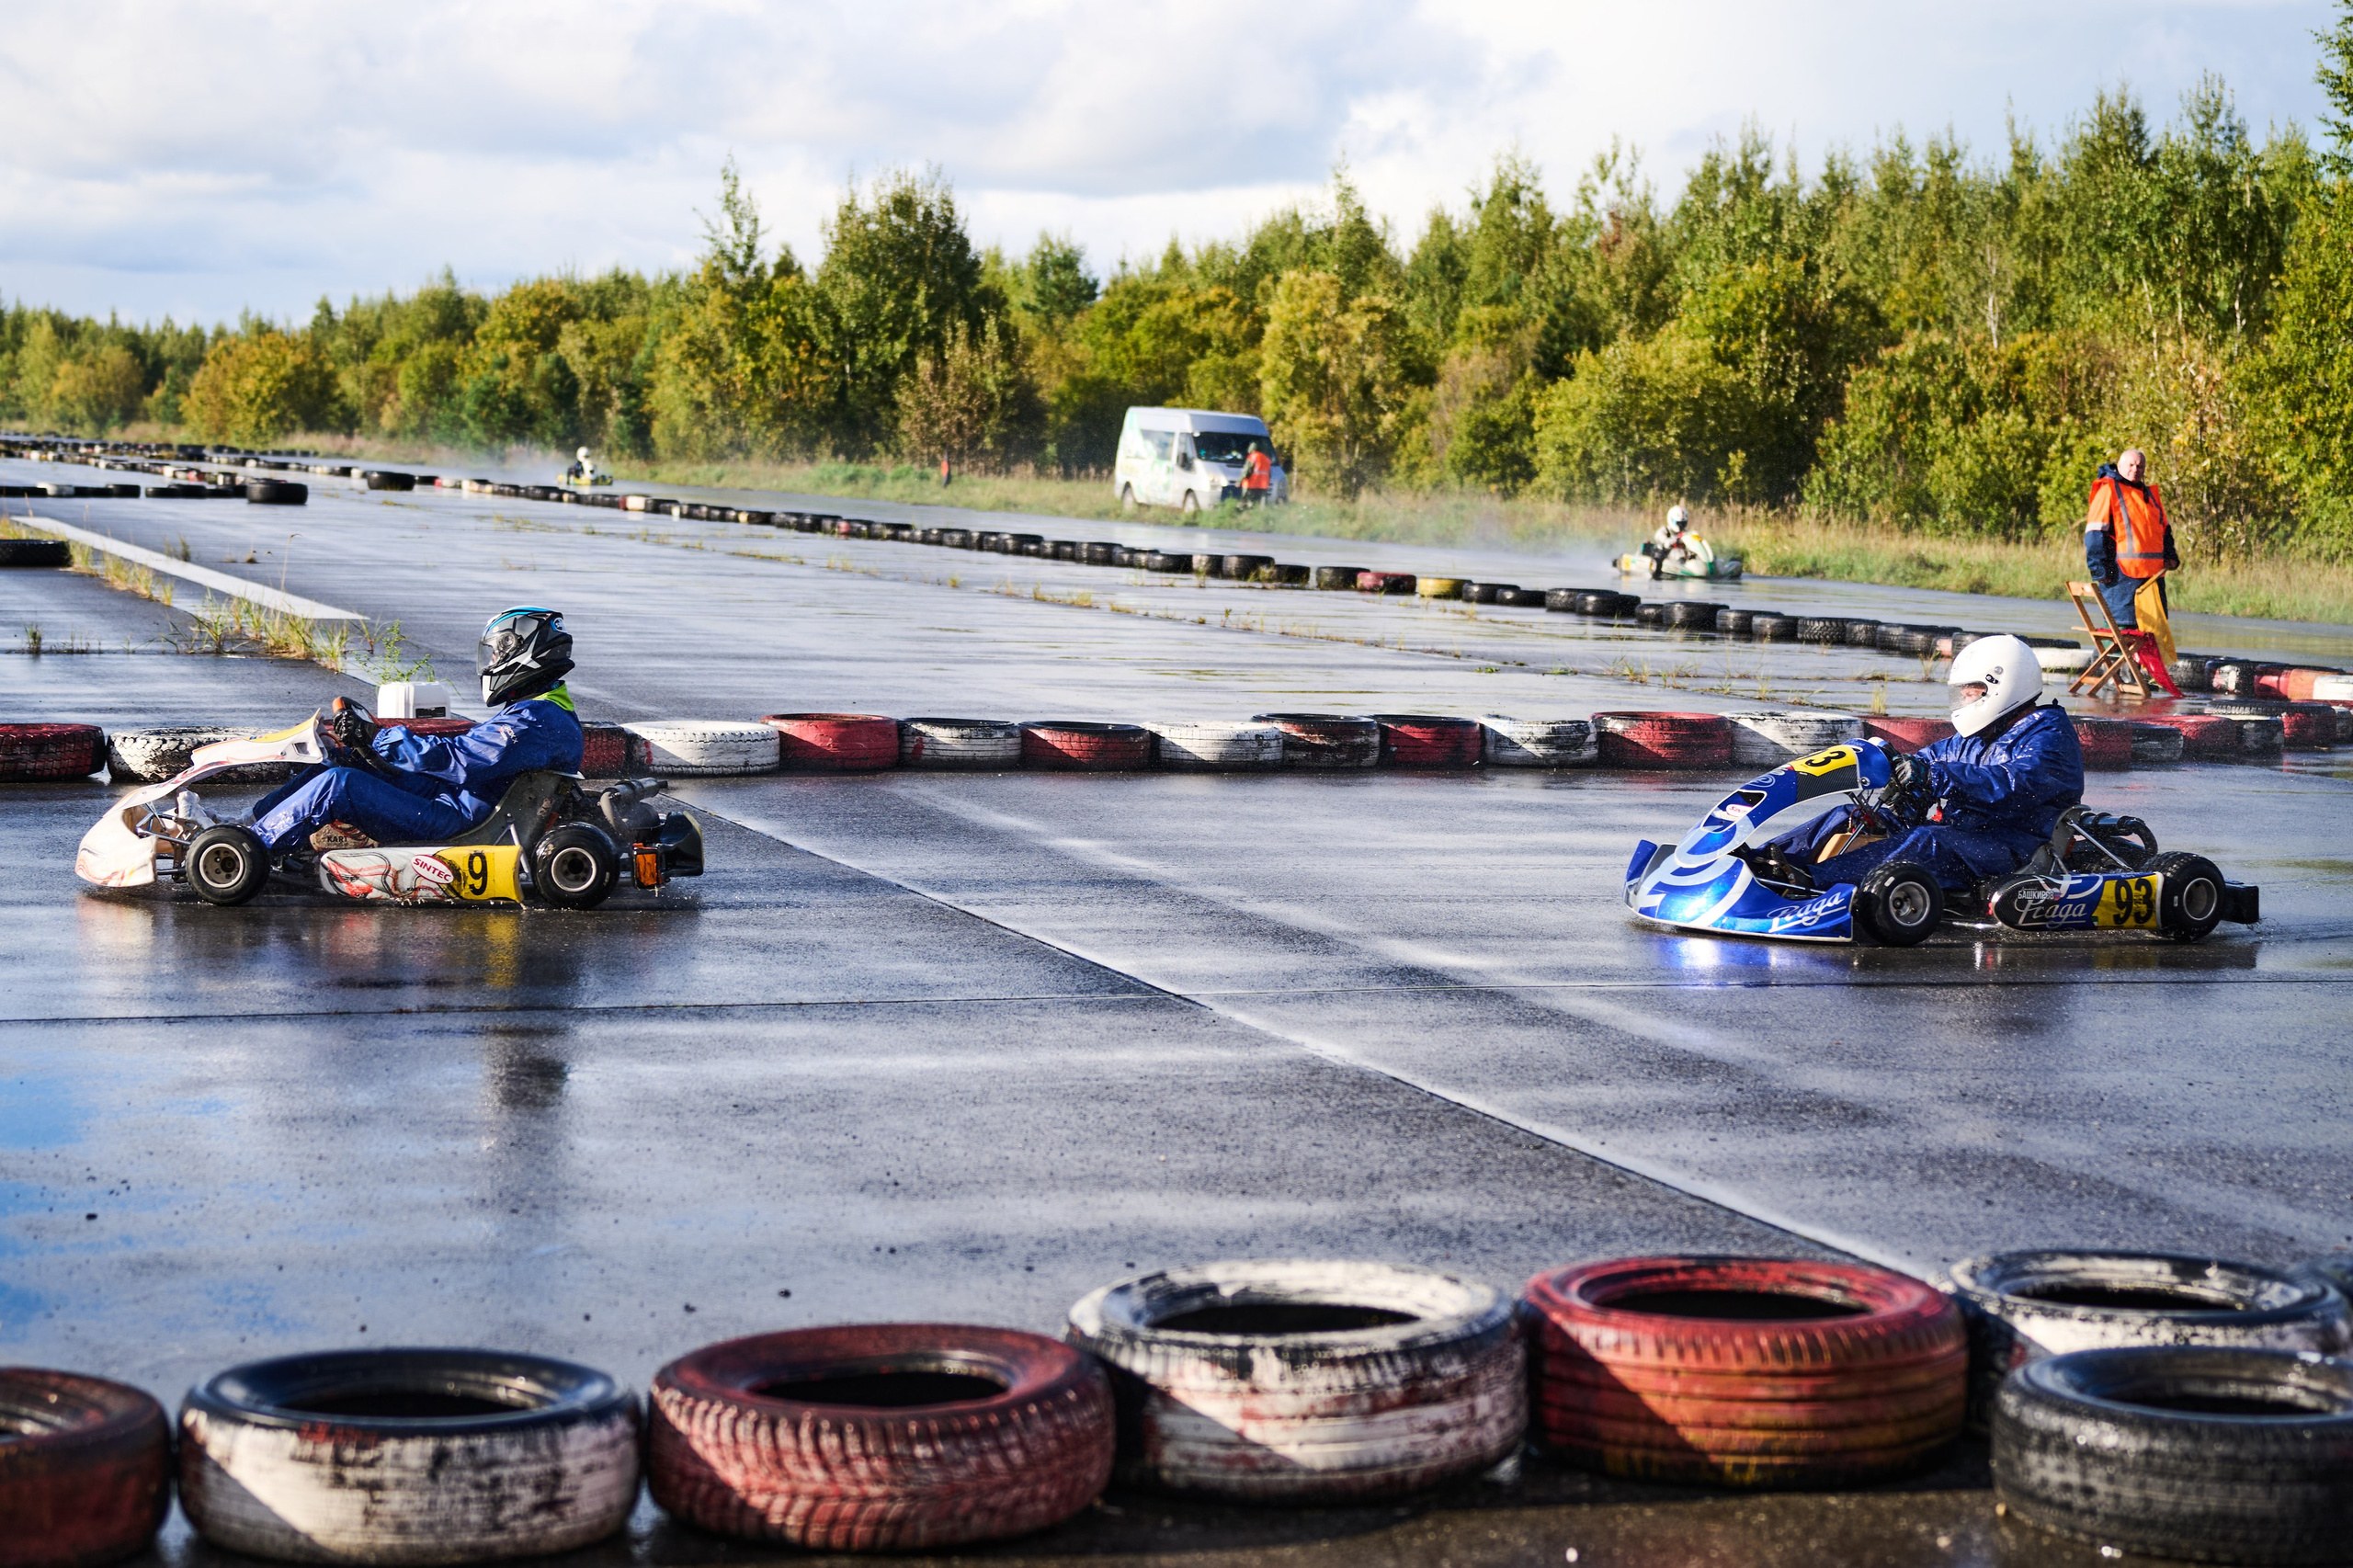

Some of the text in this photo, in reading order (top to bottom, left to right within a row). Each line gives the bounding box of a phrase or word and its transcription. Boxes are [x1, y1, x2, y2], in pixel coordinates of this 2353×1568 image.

[413, 858, 451, 881] SINTEC
[467, 852, 488, 896] 9
[2113, 878, 2154, 925] 93
